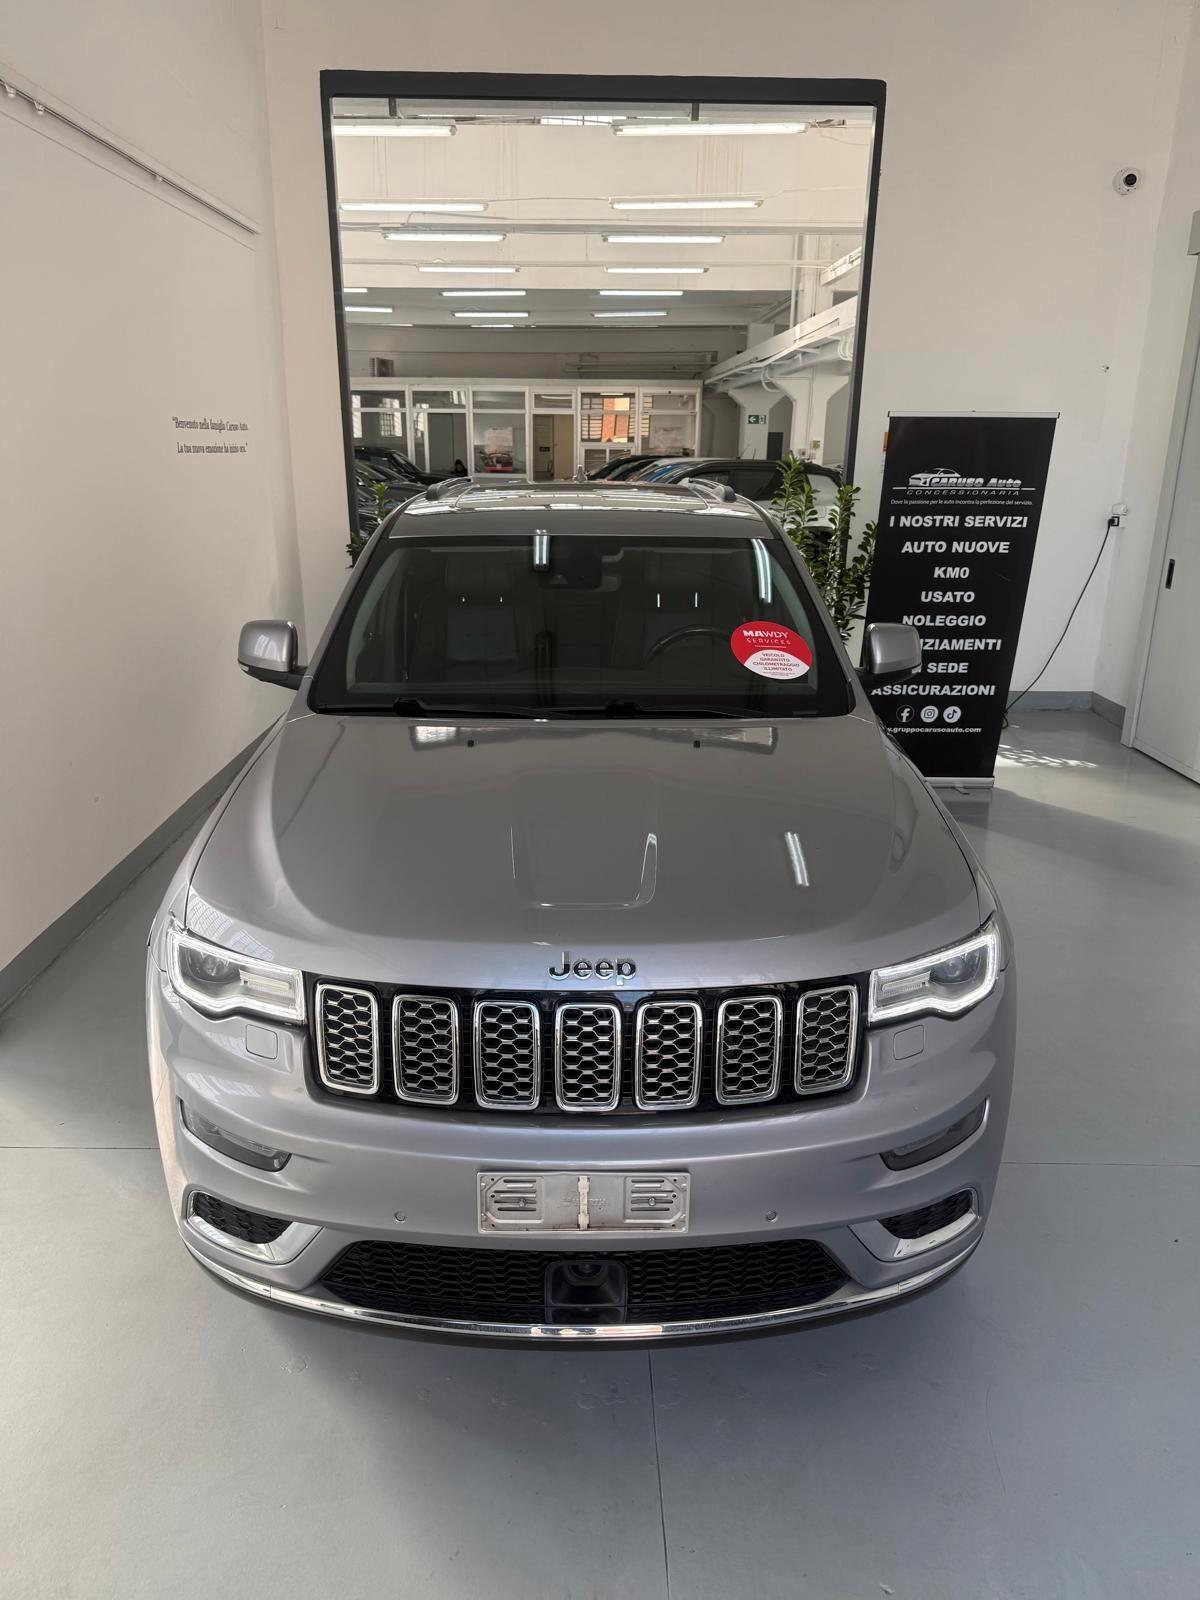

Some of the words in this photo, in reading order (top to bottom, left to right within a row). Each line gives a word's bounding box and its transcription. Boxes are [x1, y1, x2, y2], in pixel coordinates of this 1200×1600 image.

[930, 477, 984, 487] CARUSO
[986, 478, 1022, 488] Auto
[889, 515, 895, 528] I
[899, 515, 960, 528] NOSTRI
[964, 516, 1028, 528] SERVIZI
[901, 541, 947, 553] AUTO
[951, 541, 1010, 554] NUOVE
[920, 591, 976, 603] USATO
[902, 615, 987, 627] NOLEGGIO
[742, 630, 789, 639] MAWDY
[926, 662, 969, 674] SEDE
[870, 684, 996, 696] ASSICURAZIONI
[548, 951, 636, 986] Jeep
